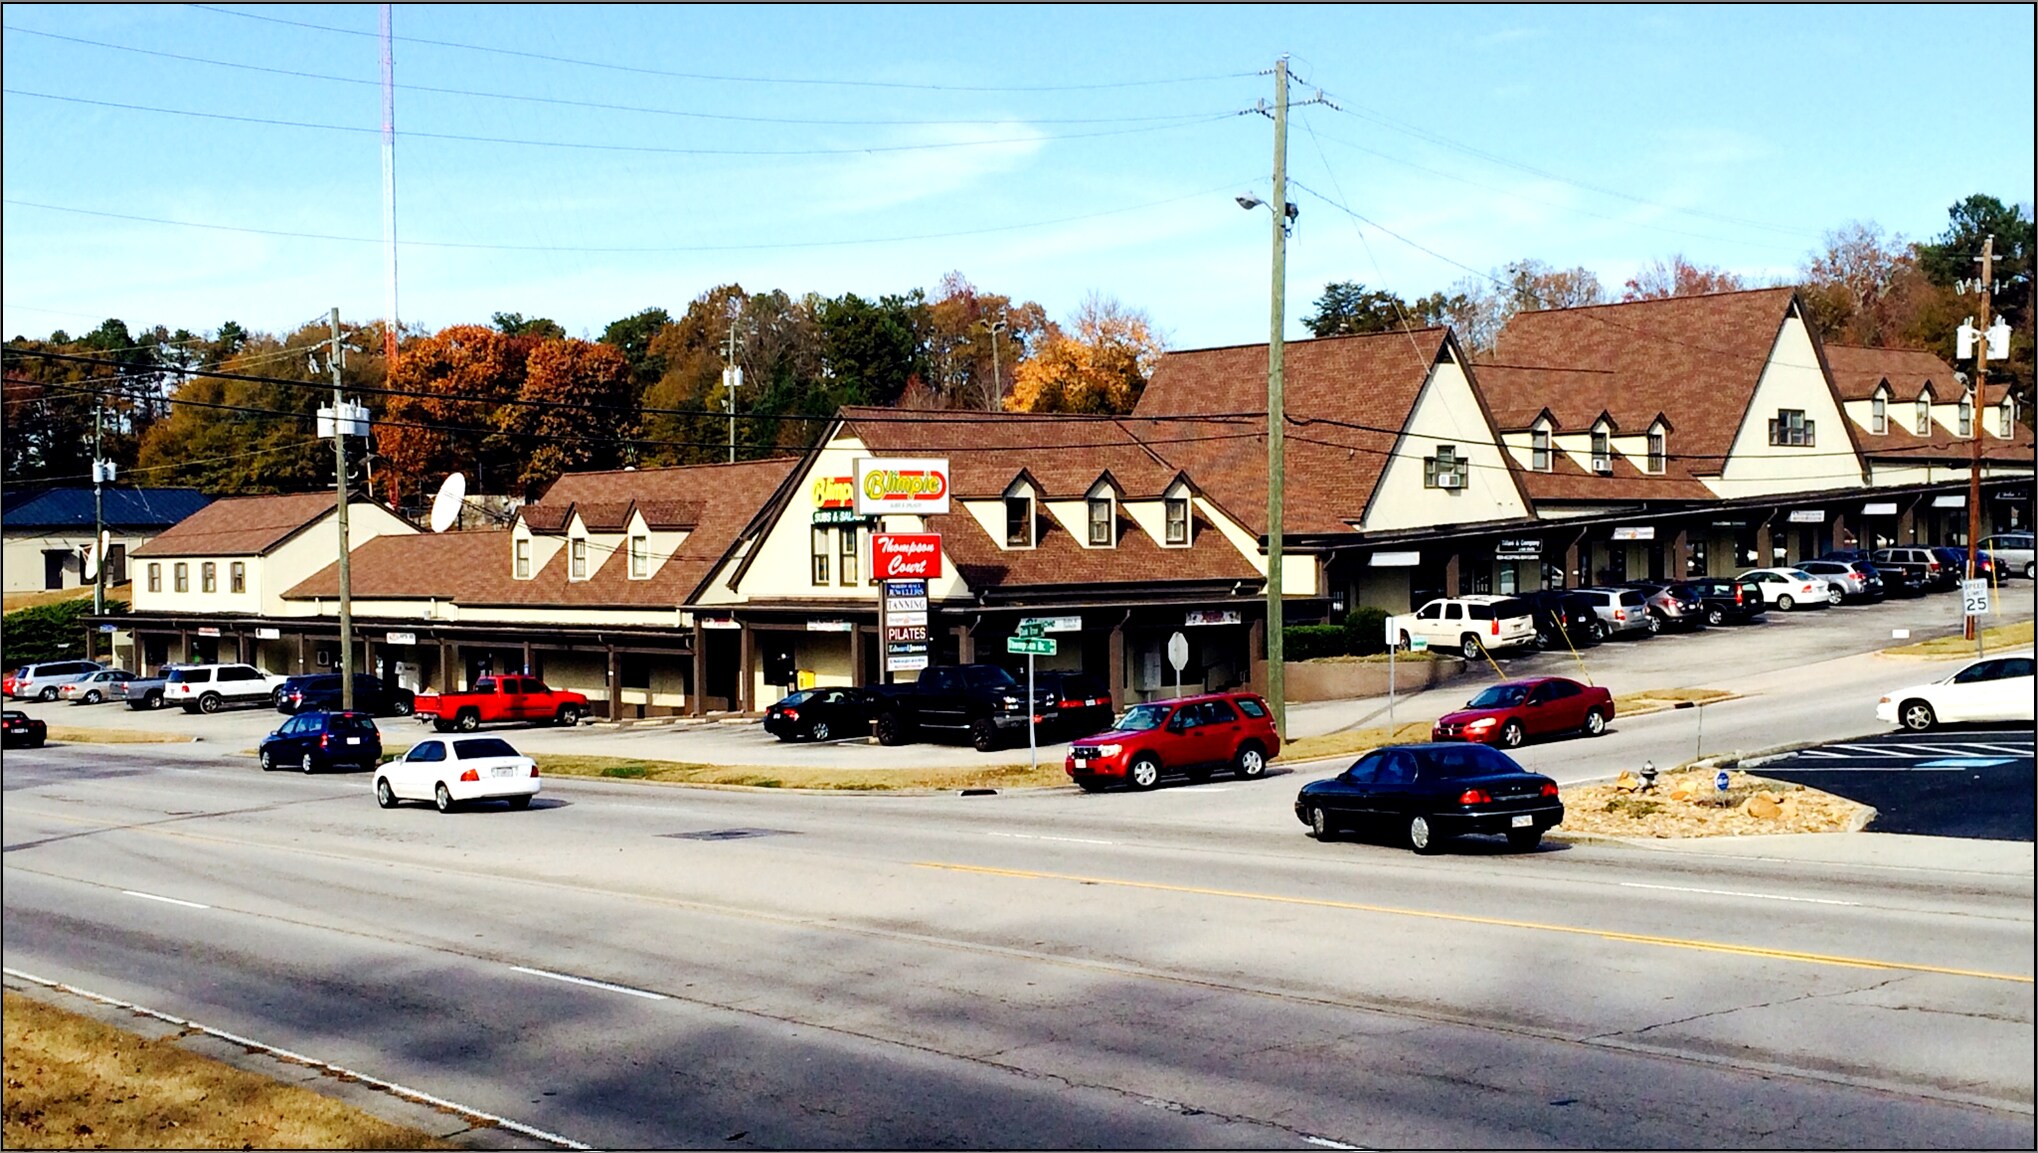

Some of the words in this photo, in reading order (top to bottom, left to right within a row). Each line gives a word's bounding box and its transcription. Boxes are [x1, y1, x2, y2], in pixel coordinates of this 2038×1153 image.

[813, 478, 853, 508] Blimp
[864, 470, 940, 500] Blimpie
[814, 512, 831, 523] SUBS
[877, 536, 935, 556] Thompson
[887, 555, 927, 575] Court
[888, 599, 925, 610] TANNING
[1966, 597, 1987, 611] 25
[888, 627, 926, 641] PILATES
